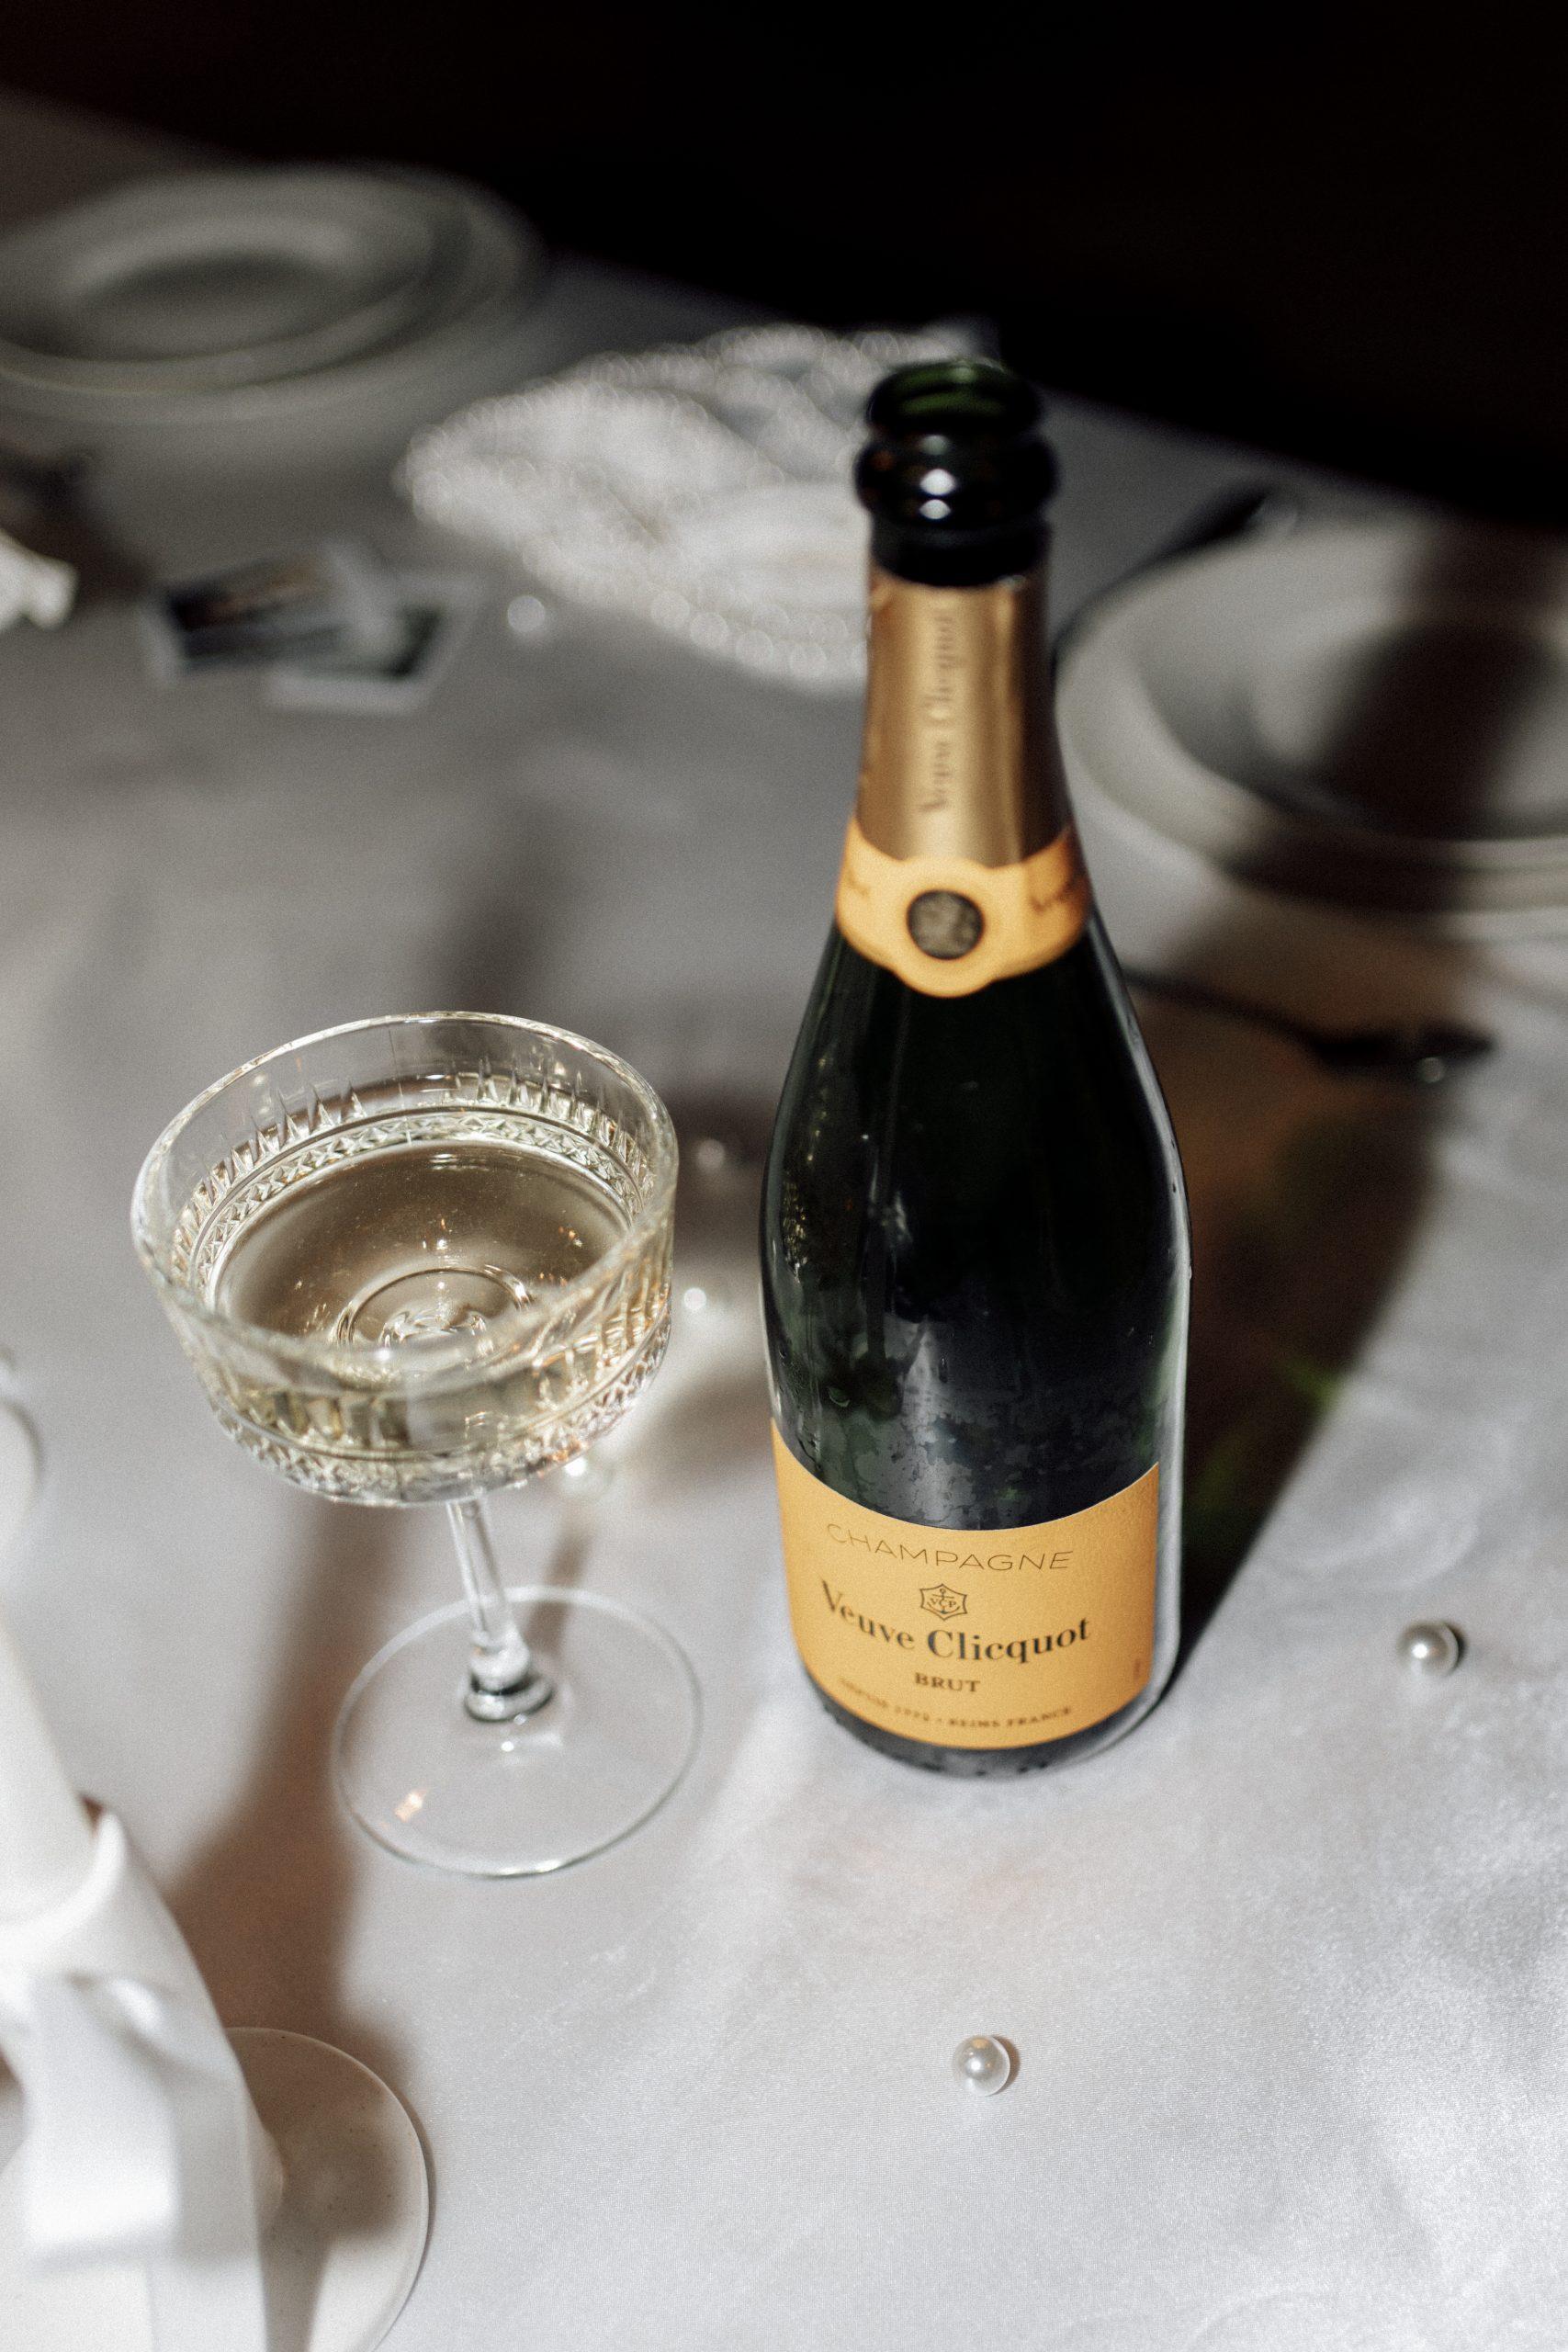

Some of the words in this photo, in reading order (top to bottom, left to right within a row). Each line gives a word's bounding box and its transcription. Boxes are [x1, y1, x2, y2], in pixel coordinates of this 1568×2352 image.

[826, 1522, 1074, 1572] CHAMPAGNE
[820, 1578, 915, 1652] Veuve
[928, 1617, 1092, 1665] Clicquot
[914, 1671, 981, 1694] BRUT
